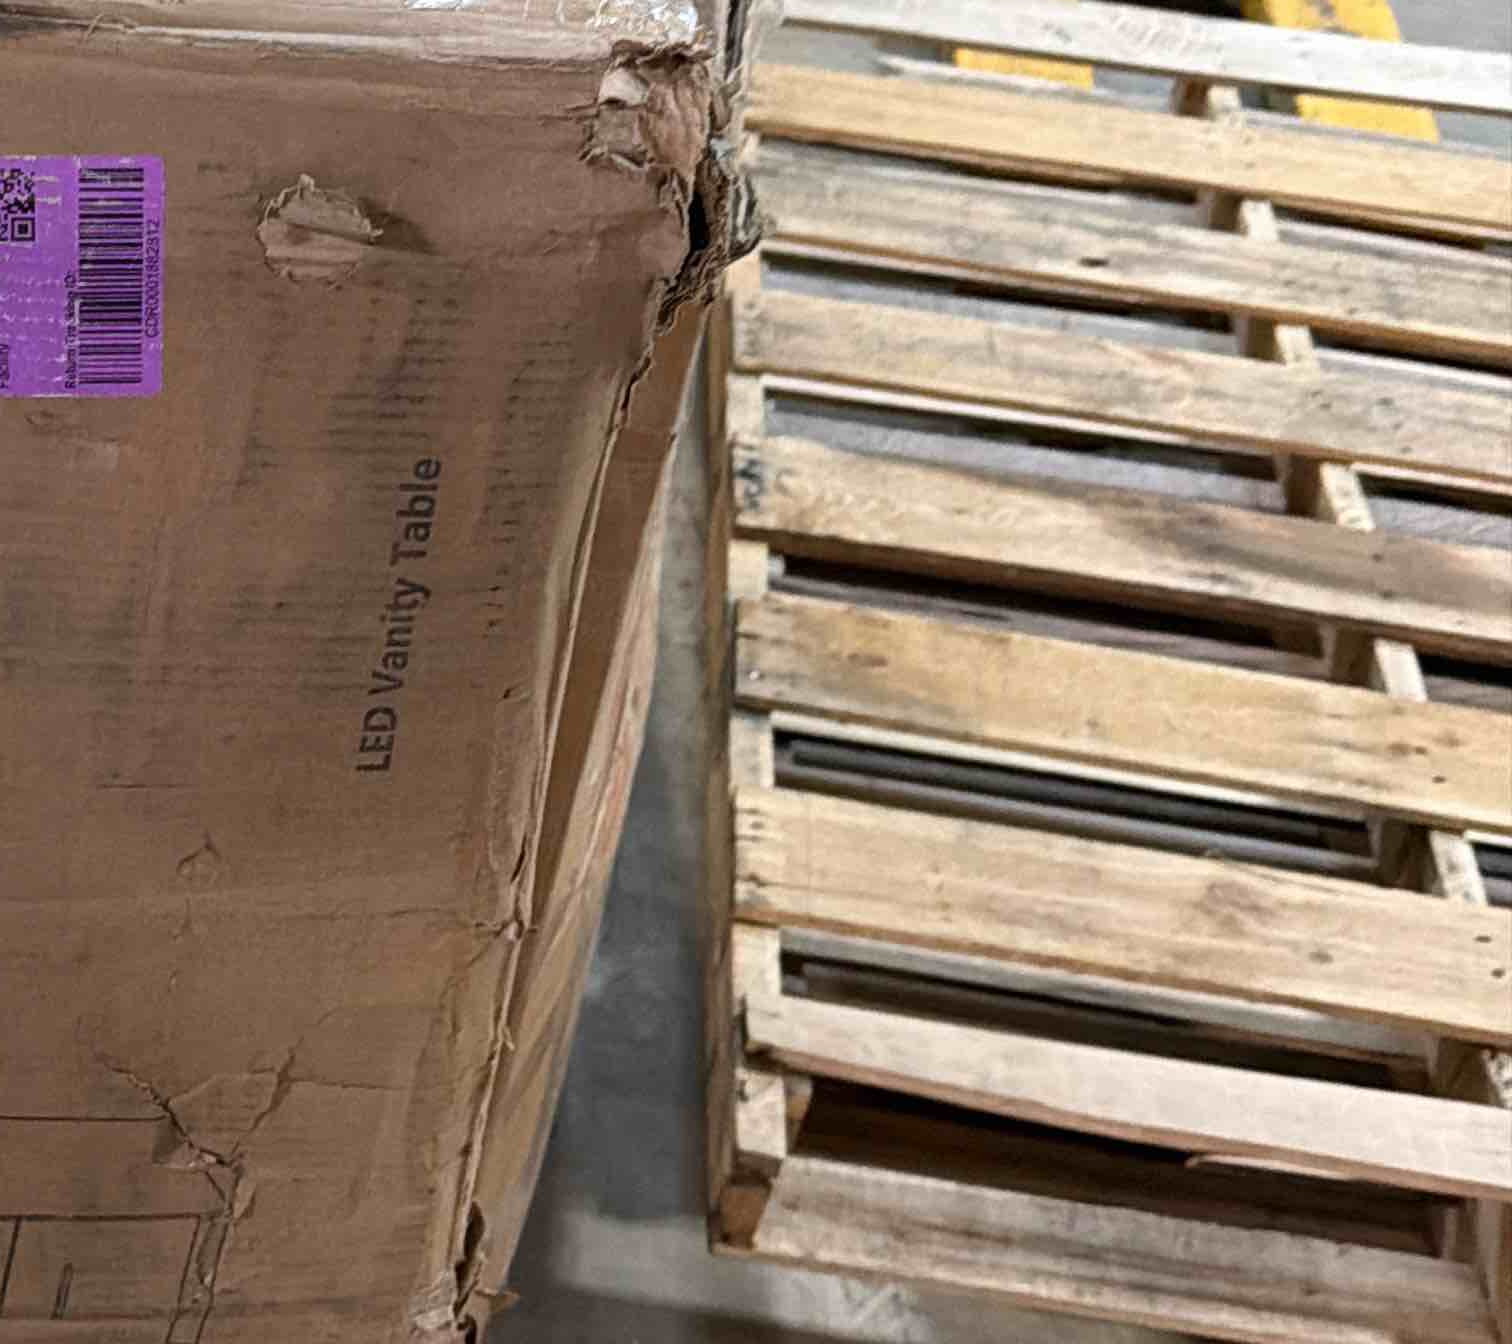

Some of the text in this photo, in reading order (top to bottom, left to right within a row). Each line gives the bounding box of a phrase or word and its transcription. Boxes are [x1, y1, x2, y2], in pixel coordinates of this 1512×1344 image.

[356, 458, 443, 774] LED Vanity Table
